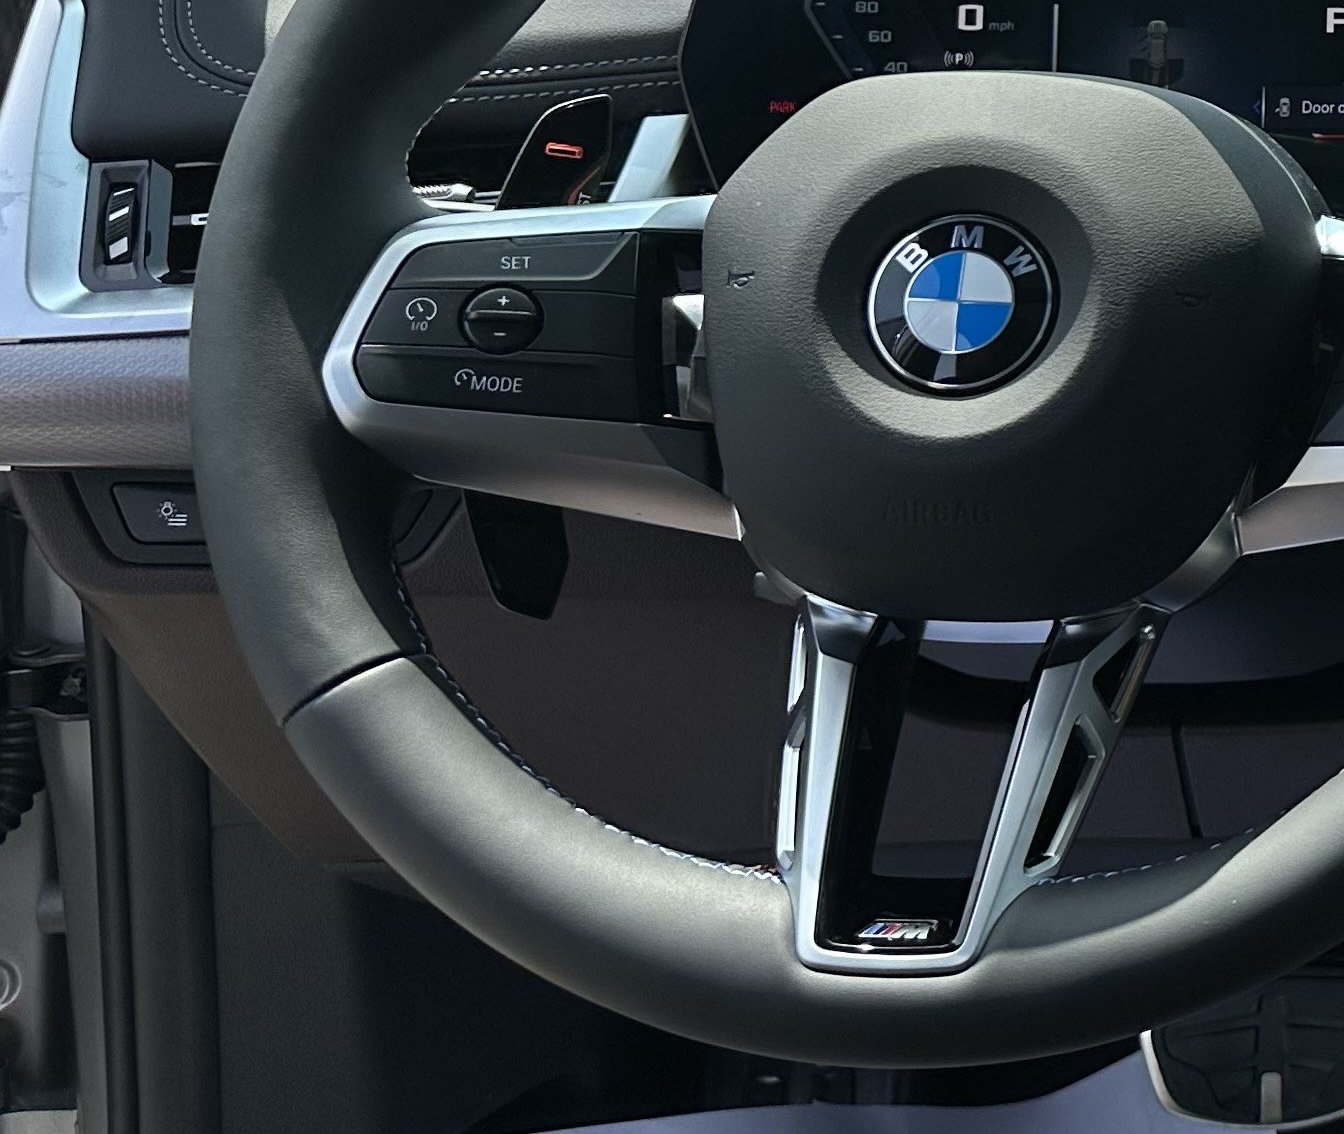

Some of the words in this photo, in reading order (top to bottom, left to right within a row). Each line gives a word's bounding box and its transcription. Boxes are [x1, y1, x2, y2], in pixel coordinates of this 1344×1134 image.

[855, 1, 879, 14] 80
[957, 3, 984, 32] 0
[988, 20, 1015, 32] mph
[868, 30, 892, 43] 60
[884, 61, 908, 73] 40
[1301, 100, 1335, 114] Door
[895, 225, 1038, 278] BMW
[500, 255, 531, 270] SET
[470, 374, 525, 394] MODE
